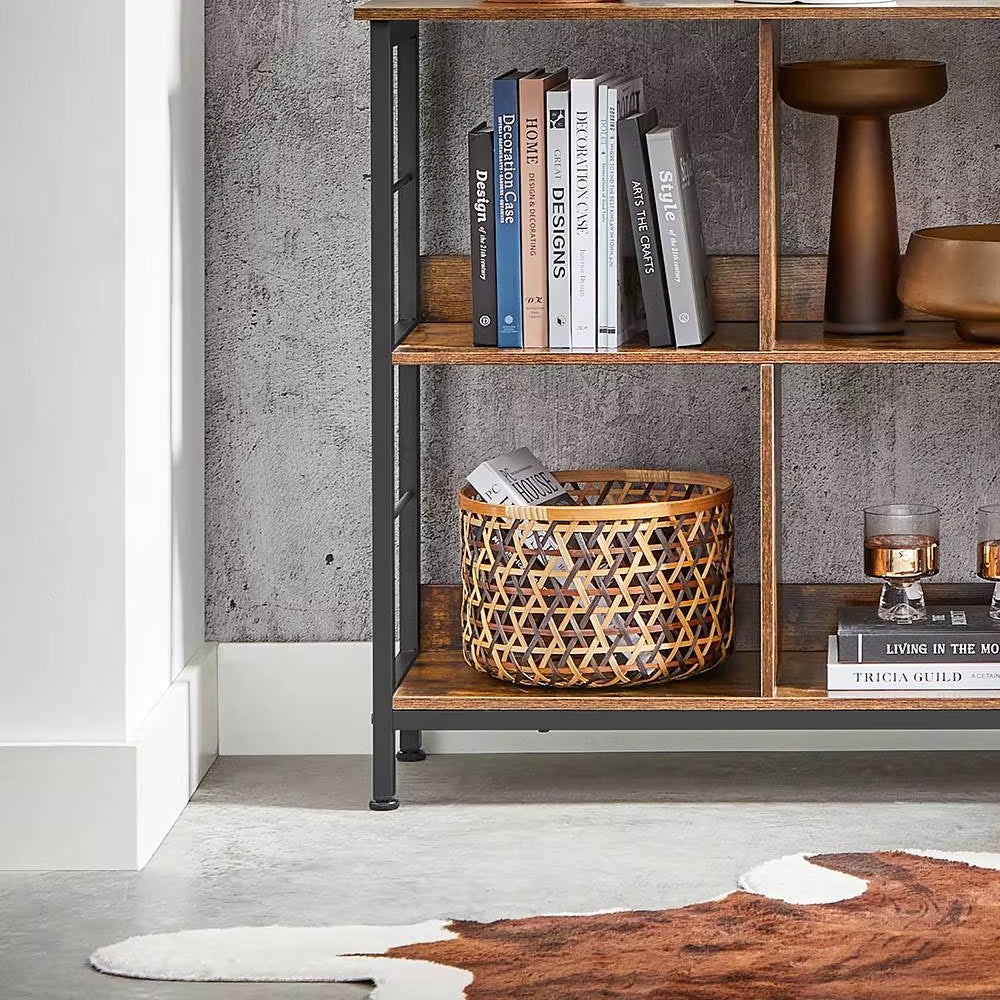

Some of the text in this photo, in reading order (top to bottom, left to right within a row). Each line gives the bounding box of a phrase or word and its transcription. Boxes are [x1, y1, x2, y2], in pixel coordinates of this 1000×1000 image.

[526, 118, 539, 165] HOME
[576, 111, 588, 198] DECORATION
[503, 114, 517, 224] Decoration Case
[474, 169, 489, 223] Design
[552, 150, 566, 279] GREAT DESIGNS
[576, 202, 588, 236] CASE
[659, 170, 678, 222] Style
[479, 226, 487, 235] of
[632, 180, 655, 274] ARTS THE CRAFTS
[485, 483, 500, 500] PC
[512, 471, 559, 503] HOUSE
[886, 643, 928, 655] LIVING
[933, 643, 945, 654] IN
[951, 643, 976, 654] THE
[853, 672, 909, 683] TRICIA
[913, 672, 963, 682] GUILD
